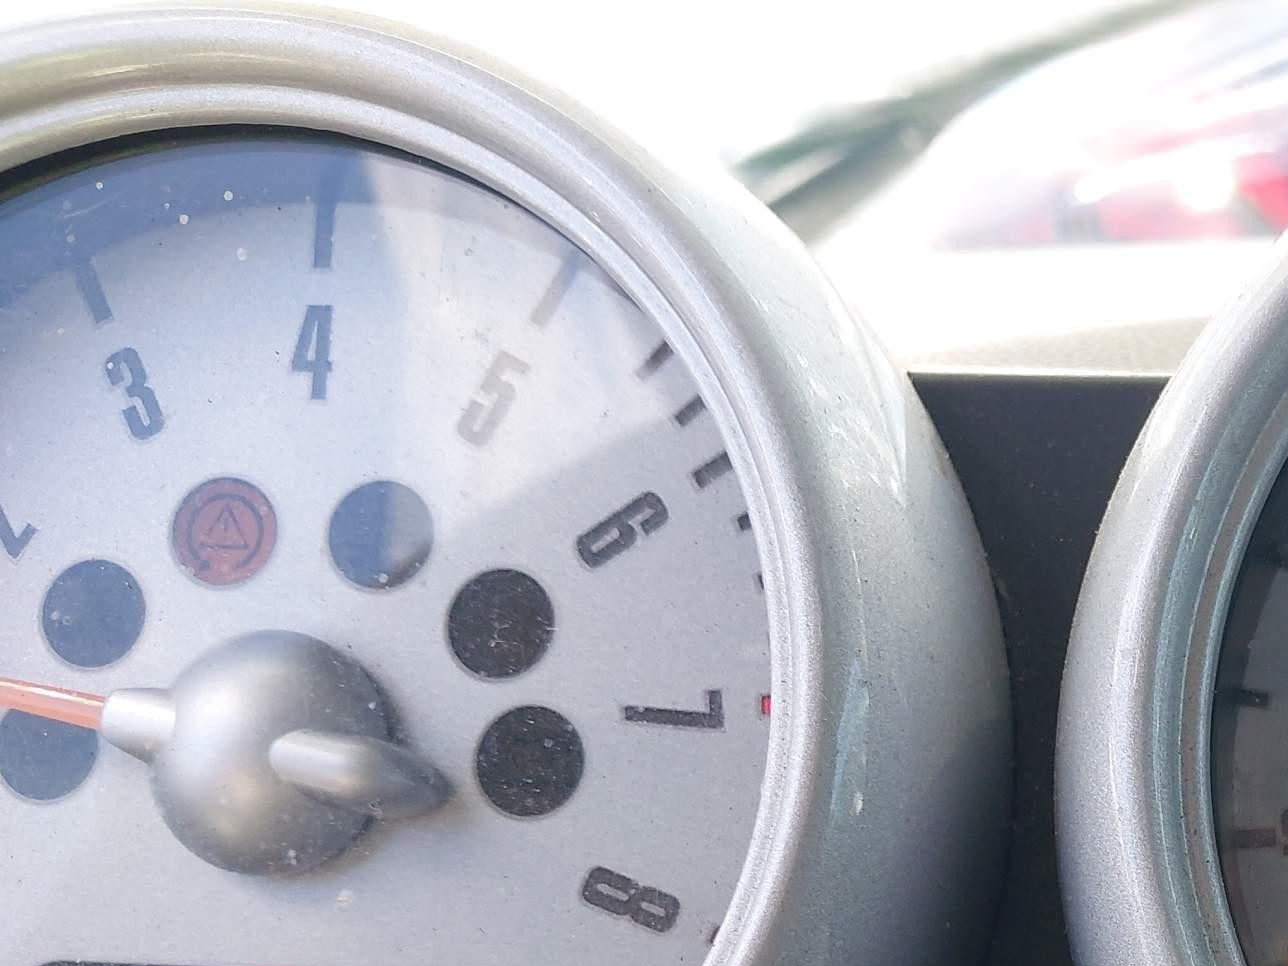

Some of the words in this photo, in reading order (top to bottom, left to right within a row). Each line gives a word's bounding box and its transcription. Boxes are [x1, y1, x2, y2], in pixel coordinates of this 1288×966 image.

[104, 347, 164, 442] 3
[291, 304, 333, 400] 4
[455, 350, 530, 447] 5
[576, 490, 669, 569] 6
[624, 689, 724, 731] 7
[581, 866, 680, 933] 8
